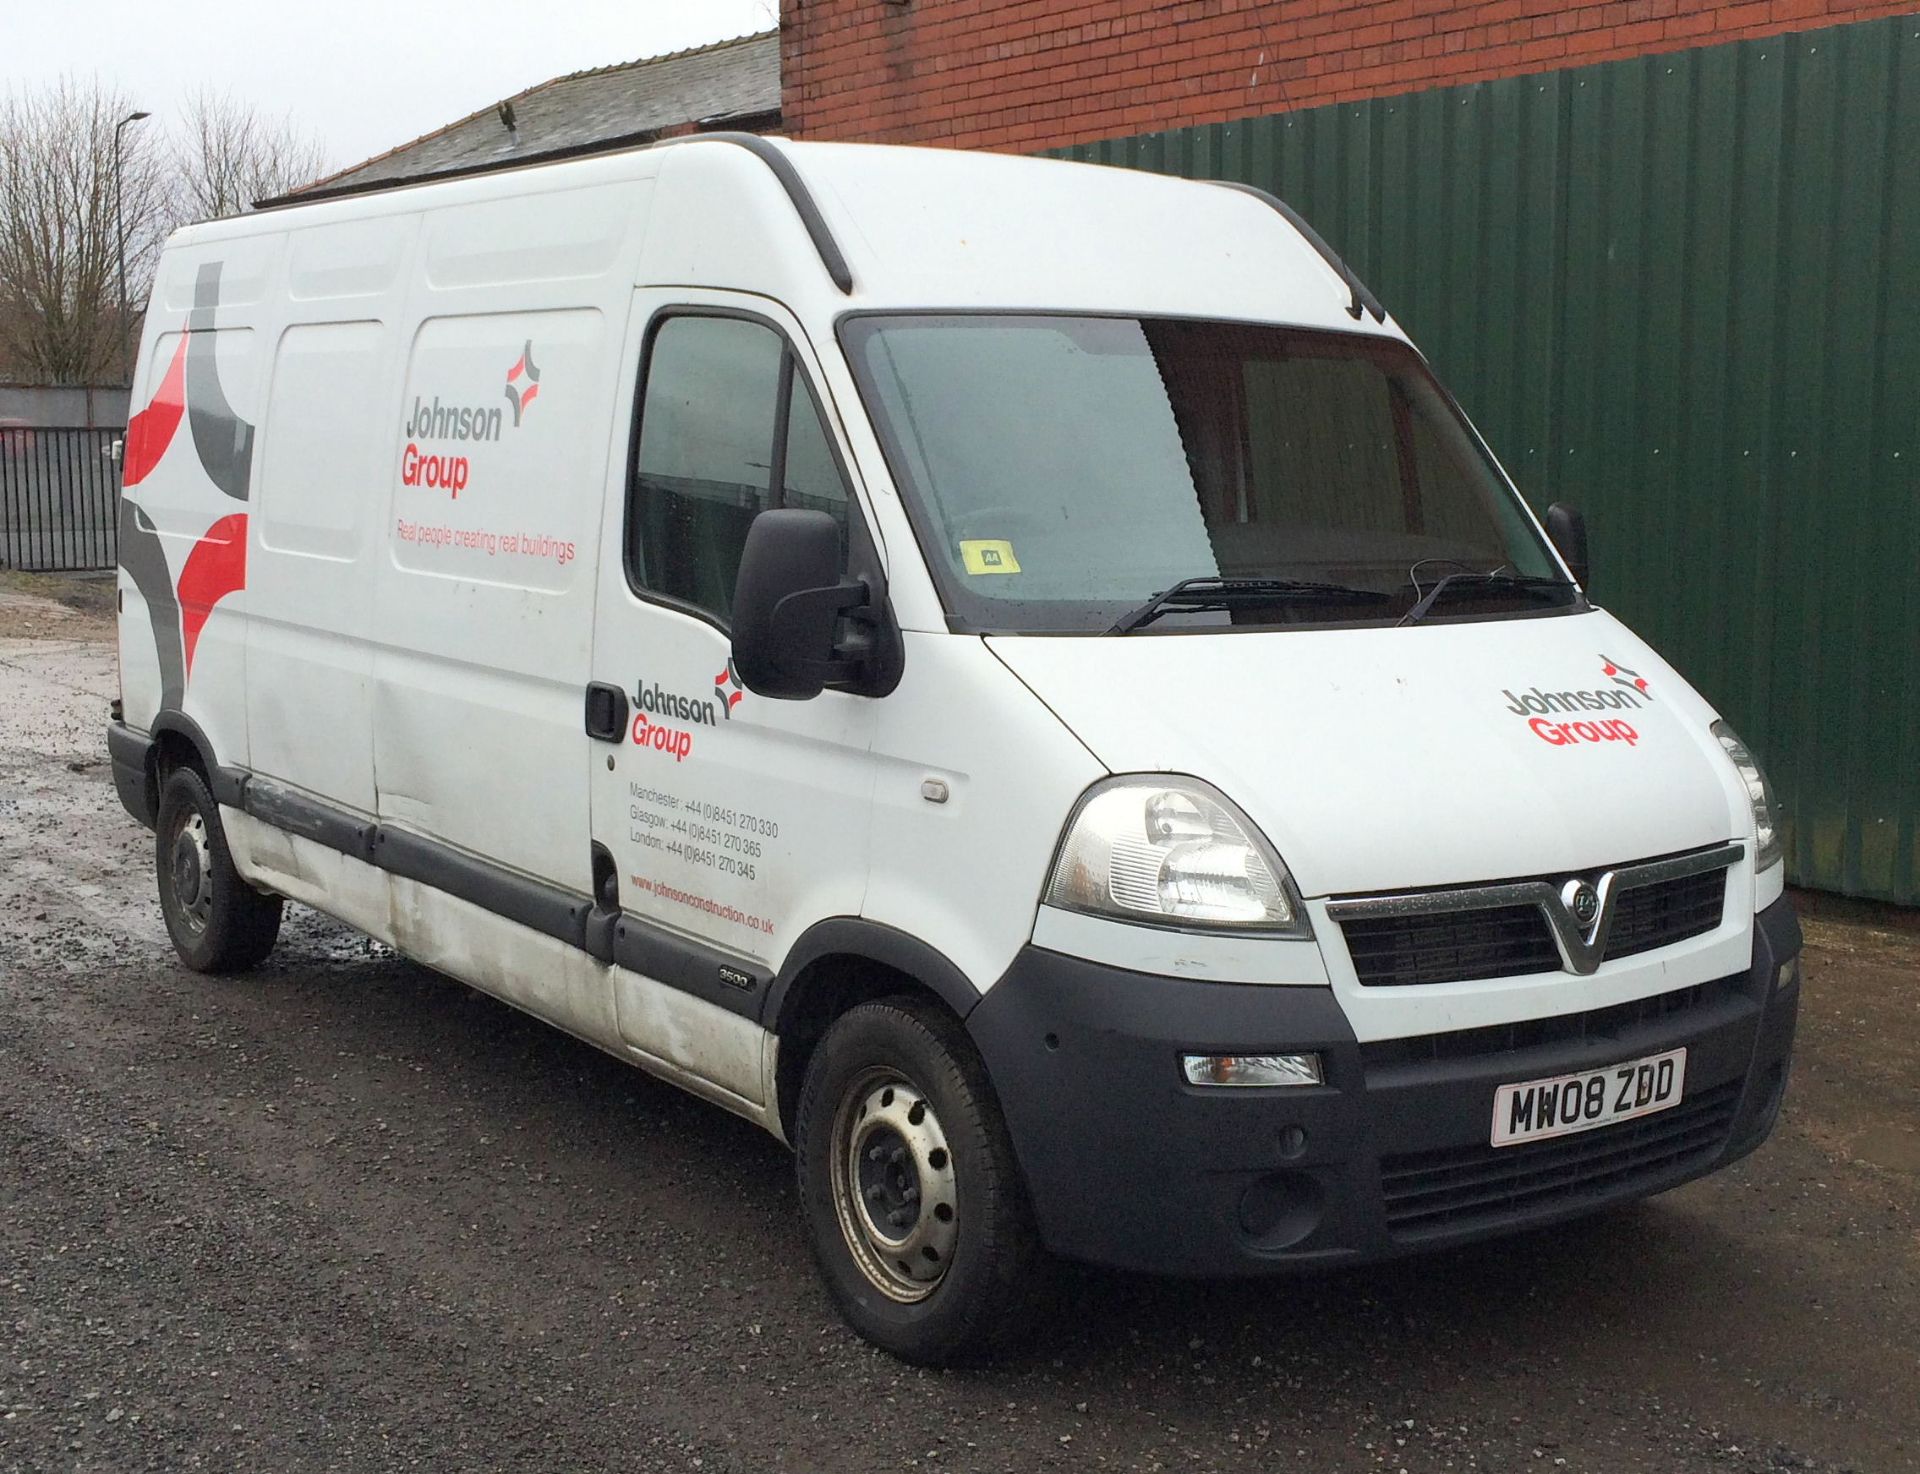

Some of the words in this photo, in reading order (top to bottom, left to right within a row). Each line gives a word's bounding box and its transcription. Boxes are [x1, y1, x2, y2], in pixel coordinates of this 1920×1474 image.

[407, 396, 502, 441] Johnson
[402, 443, 469, 499] Group
[398, 519, 417, 542] Real
[419, 525, 451, 551] people
[455, 528, 496, 556] creating
[499, 534, 519, 553] real
[522, 535, 575, 565] buildings
[986, 553, 999, 562] AA
[632, 679, 716, 726] Johnson
[1502, 687, 1642, 716] Johnson
[632, 713, 691, 762] Group
[1528, 718, 1639, 746] Group
[671, 819, 686, 833] +44
[689, 822, 721, 845] (0)8451
[724, 833, 741, 852] 270
[743, 839, 761, 857] 365
[685, 801, 701, 815] +44
[703, 804, 737, 826] (0)8451
[740, 814, 756, 832] 270
[759, 820, 778, 838] 330
[666, 840, 682, 855] +44
[684, 845, 716, 867] (0)8451
[719, 856, 735, 874] 270
[738, 862, 755, 880] 345
[631, 875, 774, 934] www.johnsonconstruction.co.uk
[1509, 1076, 1605, 1134] MW08
[1614, 1058, 1674, 1113] ZDD
